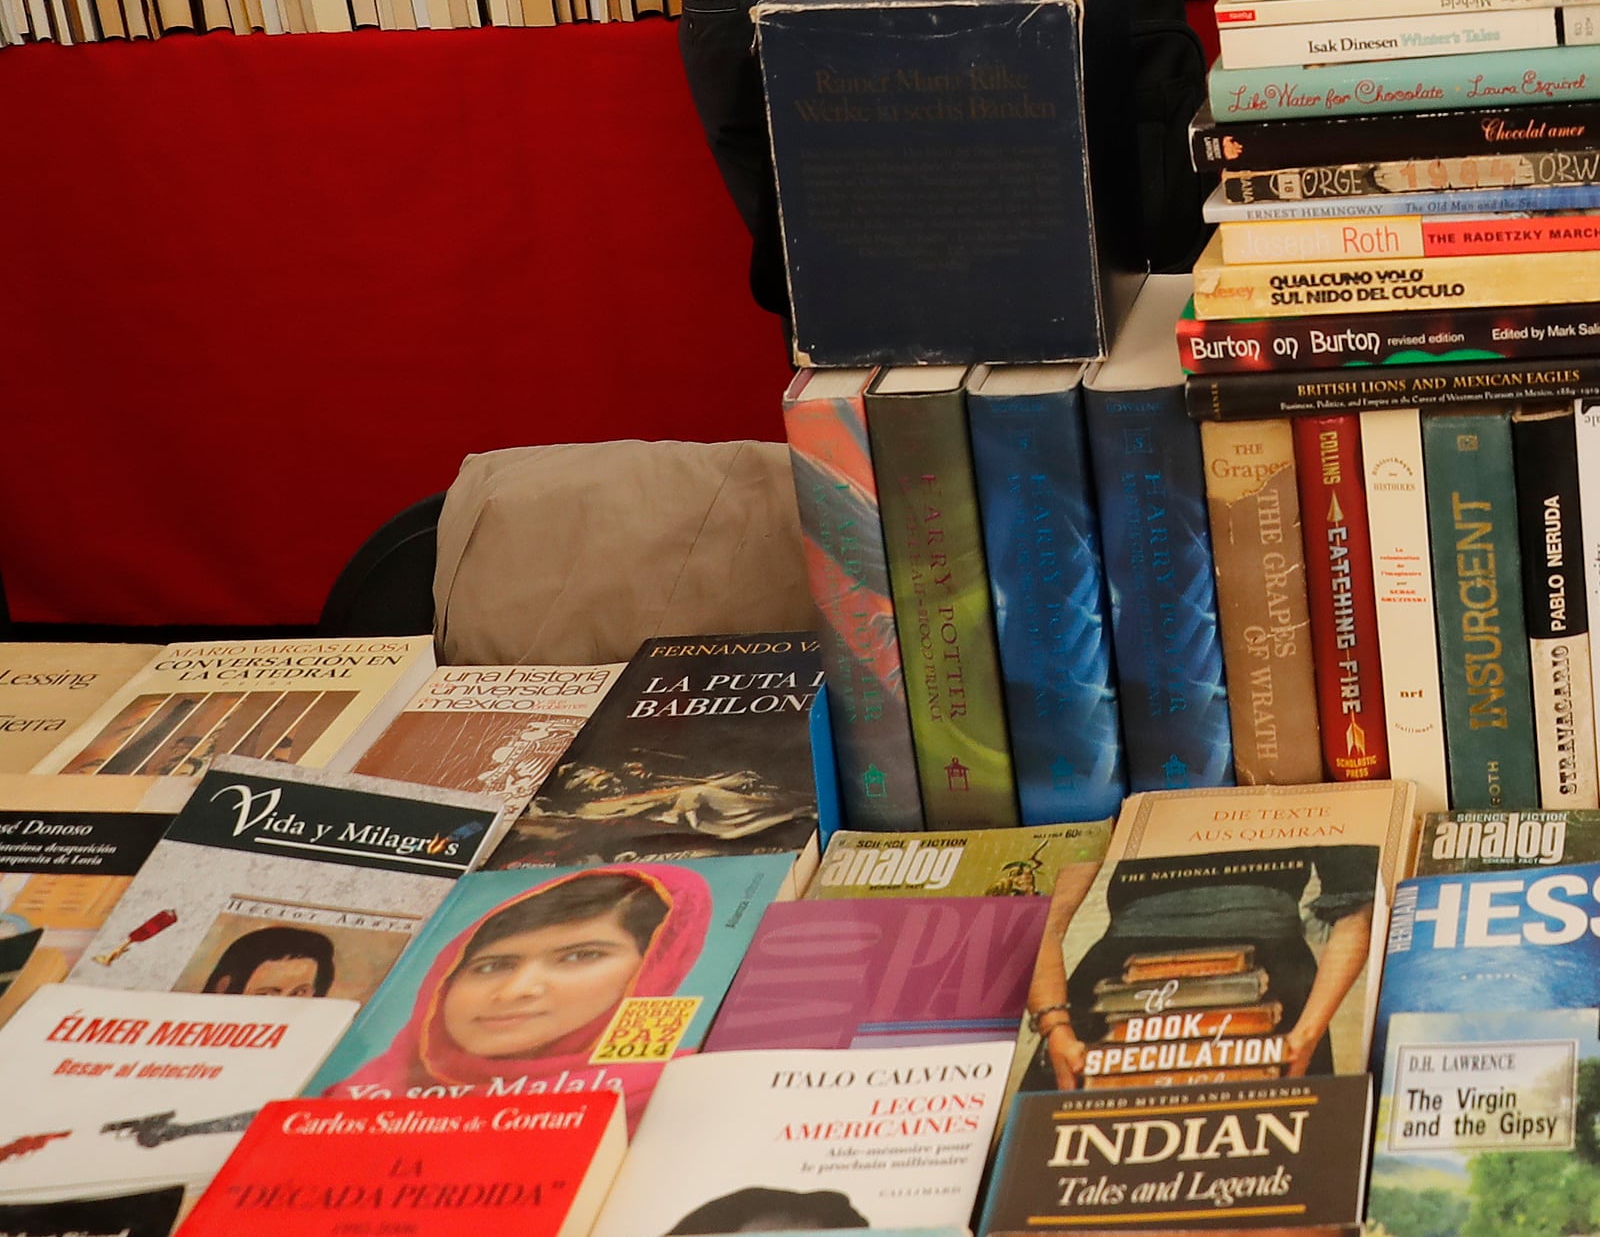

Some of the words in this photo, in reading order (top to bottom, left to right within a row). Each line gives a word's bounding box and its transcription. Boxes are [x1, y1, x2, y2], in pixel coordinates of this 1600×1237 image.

[1308, 36, 1338, 53] Isak
[1341, 34, 1398, 51] Dinesen
[1230, 88, 1267, 113] Like
[1269, 83, 1321, 108] Water
[1326, 89, 1351, 107] for
[1354, 80, 1444, 104] Chocolate
[1344, 225, 1399, 253] Roth
[1428, 232, 1456, 245] THE
[1464, 230, 1542, 244] RADETZKY
[1271, 291, 1304, 305] SUL
[1307, 289, 1353, 304] NIDO
[1357, 287, 1390, 301] DEL
[1392, 284, 1465, 298] CUCULO
[1492, 326, 1527, 340] Edited
[1531, 327, 1544, 340] by
[1548, 323, 1574, 336] Mark
[1191, 336, 1260, 361] Burton
[1273, 338, 1299, 358] on
[1311, 332, 1380, 355] Burton
[1298, 380, 1356, 396] BRITISH
[1361, 378, 1407, 393] LIONS
[1412, 376, 1447, 390] AND
[1453, 372, 1521, 388] MEXICAN
[1526, 369, 1580, 384] EAGLES
[1546, 495, 1562, 566] NERUDA
[1451, 491, 1507, 730] INSURGENT
[1549, 574, 1567, 631] PABLO
[155, 654, 365, 672] CONVERSACIÓN
[368, 654, 403, 669] EN
[178, 668, 217, 682] LA
[225, 666, 353, 681] CATEDRAL
[642, 678, 691, 695] LA
[704, 672, 800, 691] PUTA
[1338, 660, 1361, 715] FIRE
[210, 784, 307, 837] Vida
[313, 822, 333, 841] y
[1432, 812, 1568, 864] analog
[146, 1022, 288, 1050] MENDOZA
[1125, 1013, 1202, 1043] BOOK
[598, 1044, 669, 1058] 2014
[1084, 1037, 1284, 1076] SPECULATION
[771, 1071, 856, 1089] ITALO
[866, 1064, 993, 1086] CALVINO
[1047, 1110, 1309, 1168] INDIAN
[1057, 1177, 1126, 1207] Tales
[1131, 1171, 1183, 1200] and
[1187, 1166, 1292, 1207] Legends
